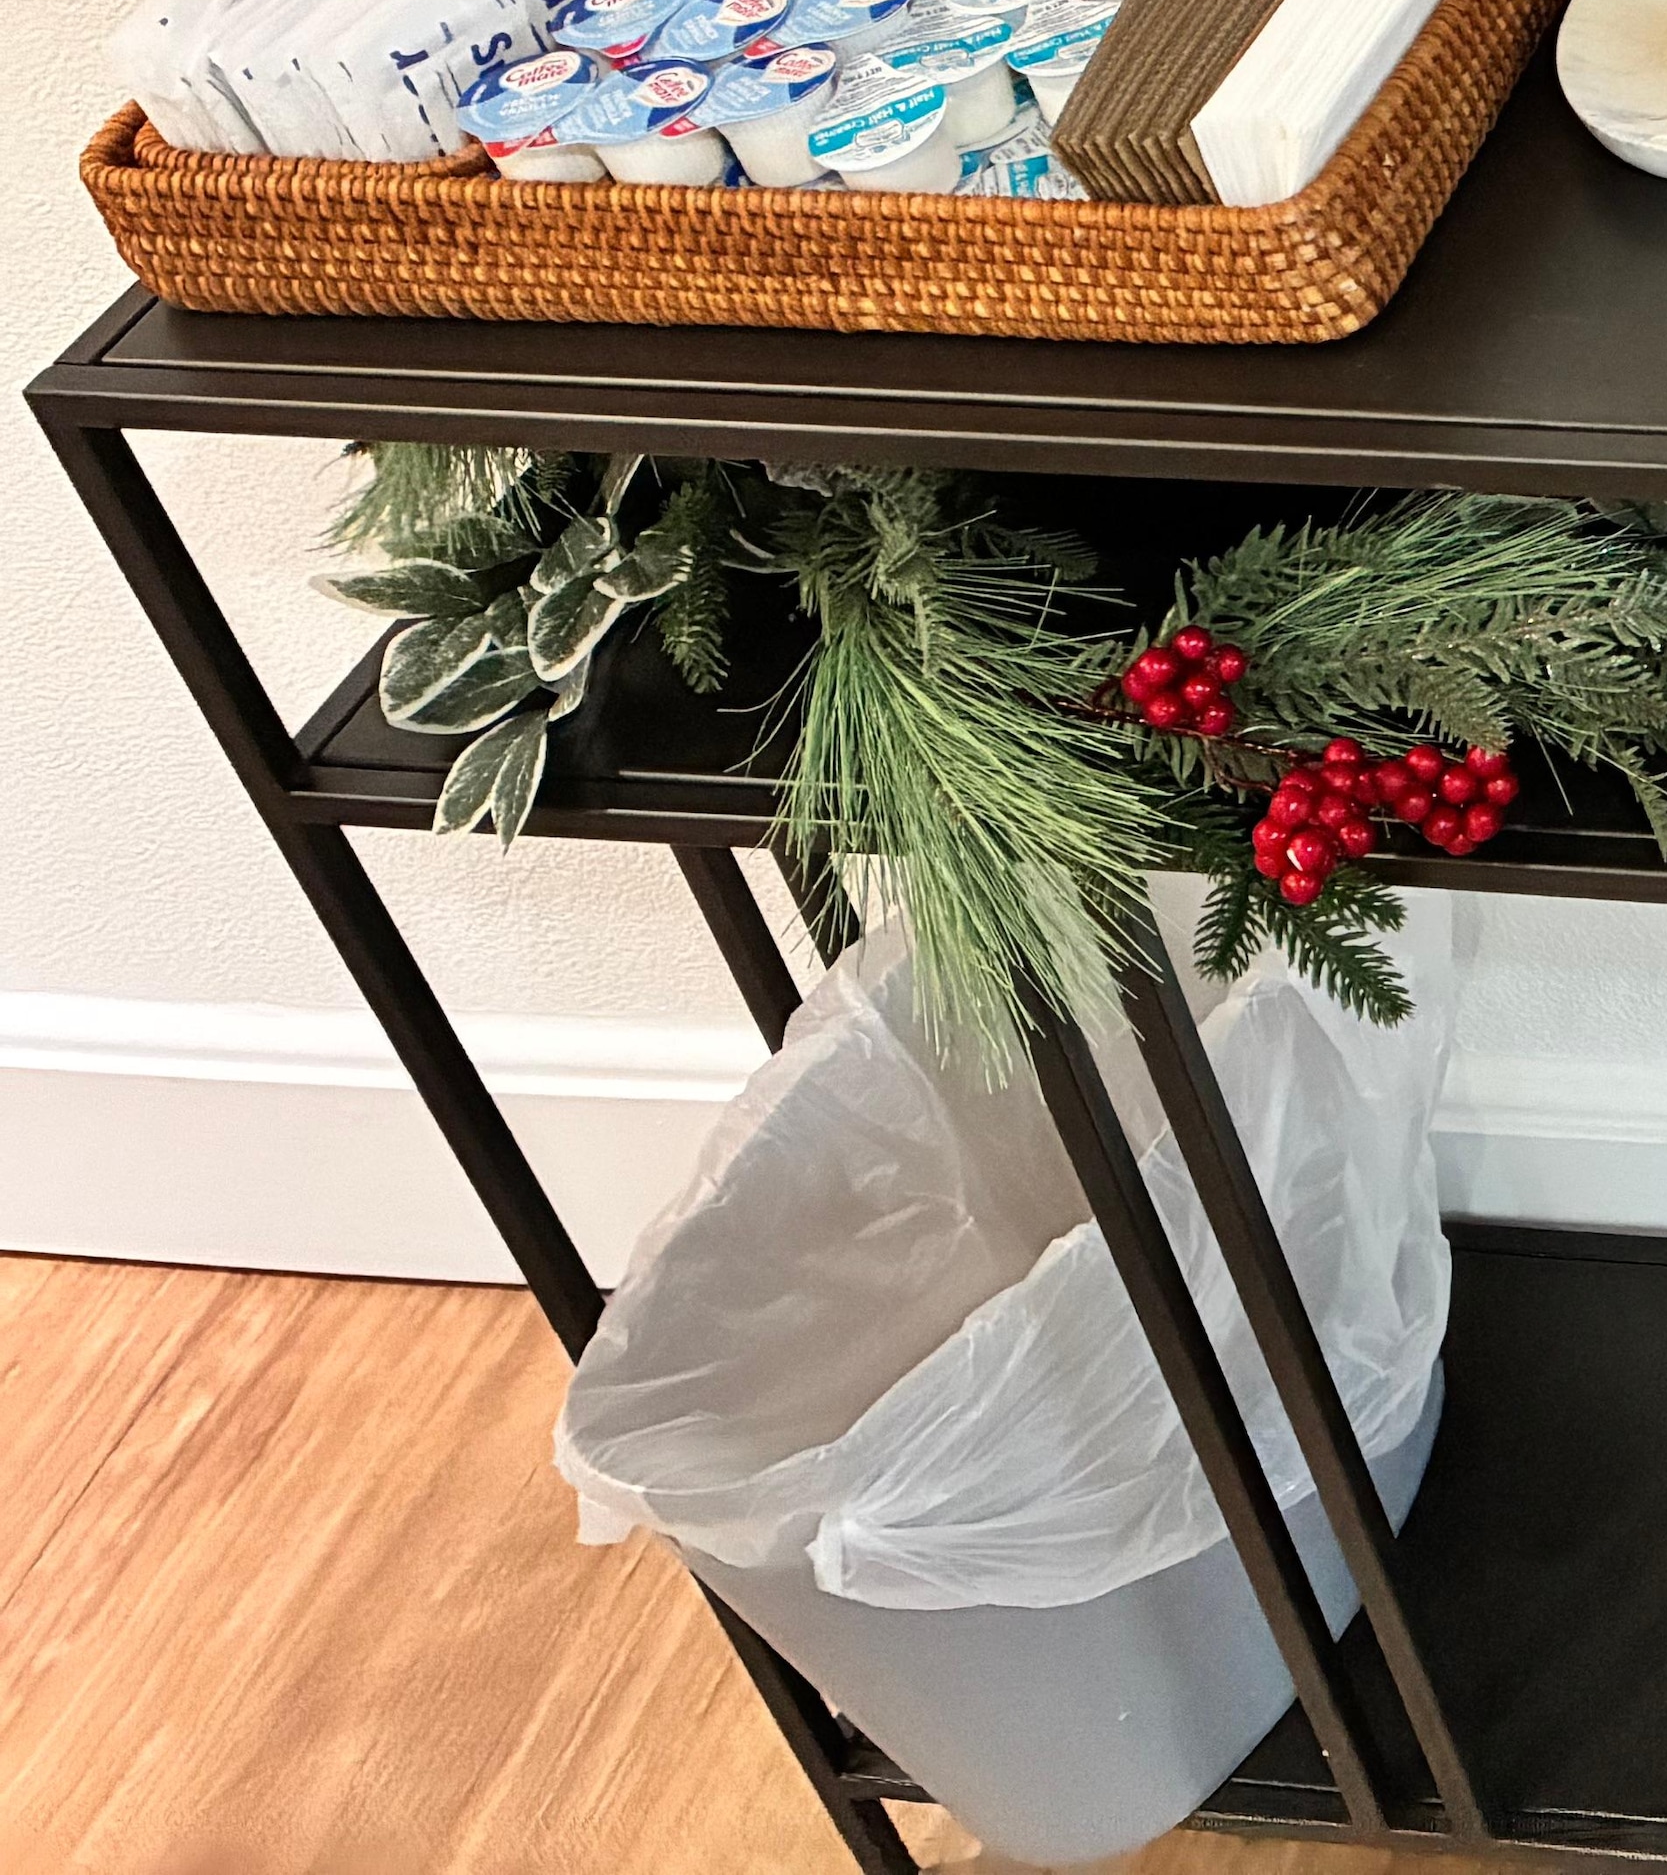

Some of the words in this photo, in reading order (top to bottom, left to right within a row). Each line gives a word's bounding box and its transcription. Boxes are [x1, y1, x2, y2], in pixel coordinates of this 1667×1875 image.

[505, 59, 568, 83] Coffee
[517, 68, 568, 87] mate
[895, 102, 907, 113] &
[908, 88, 935, 108] Half
[868, 106, 893, 125] Half
[813, 118, 865, 141] Creamer
